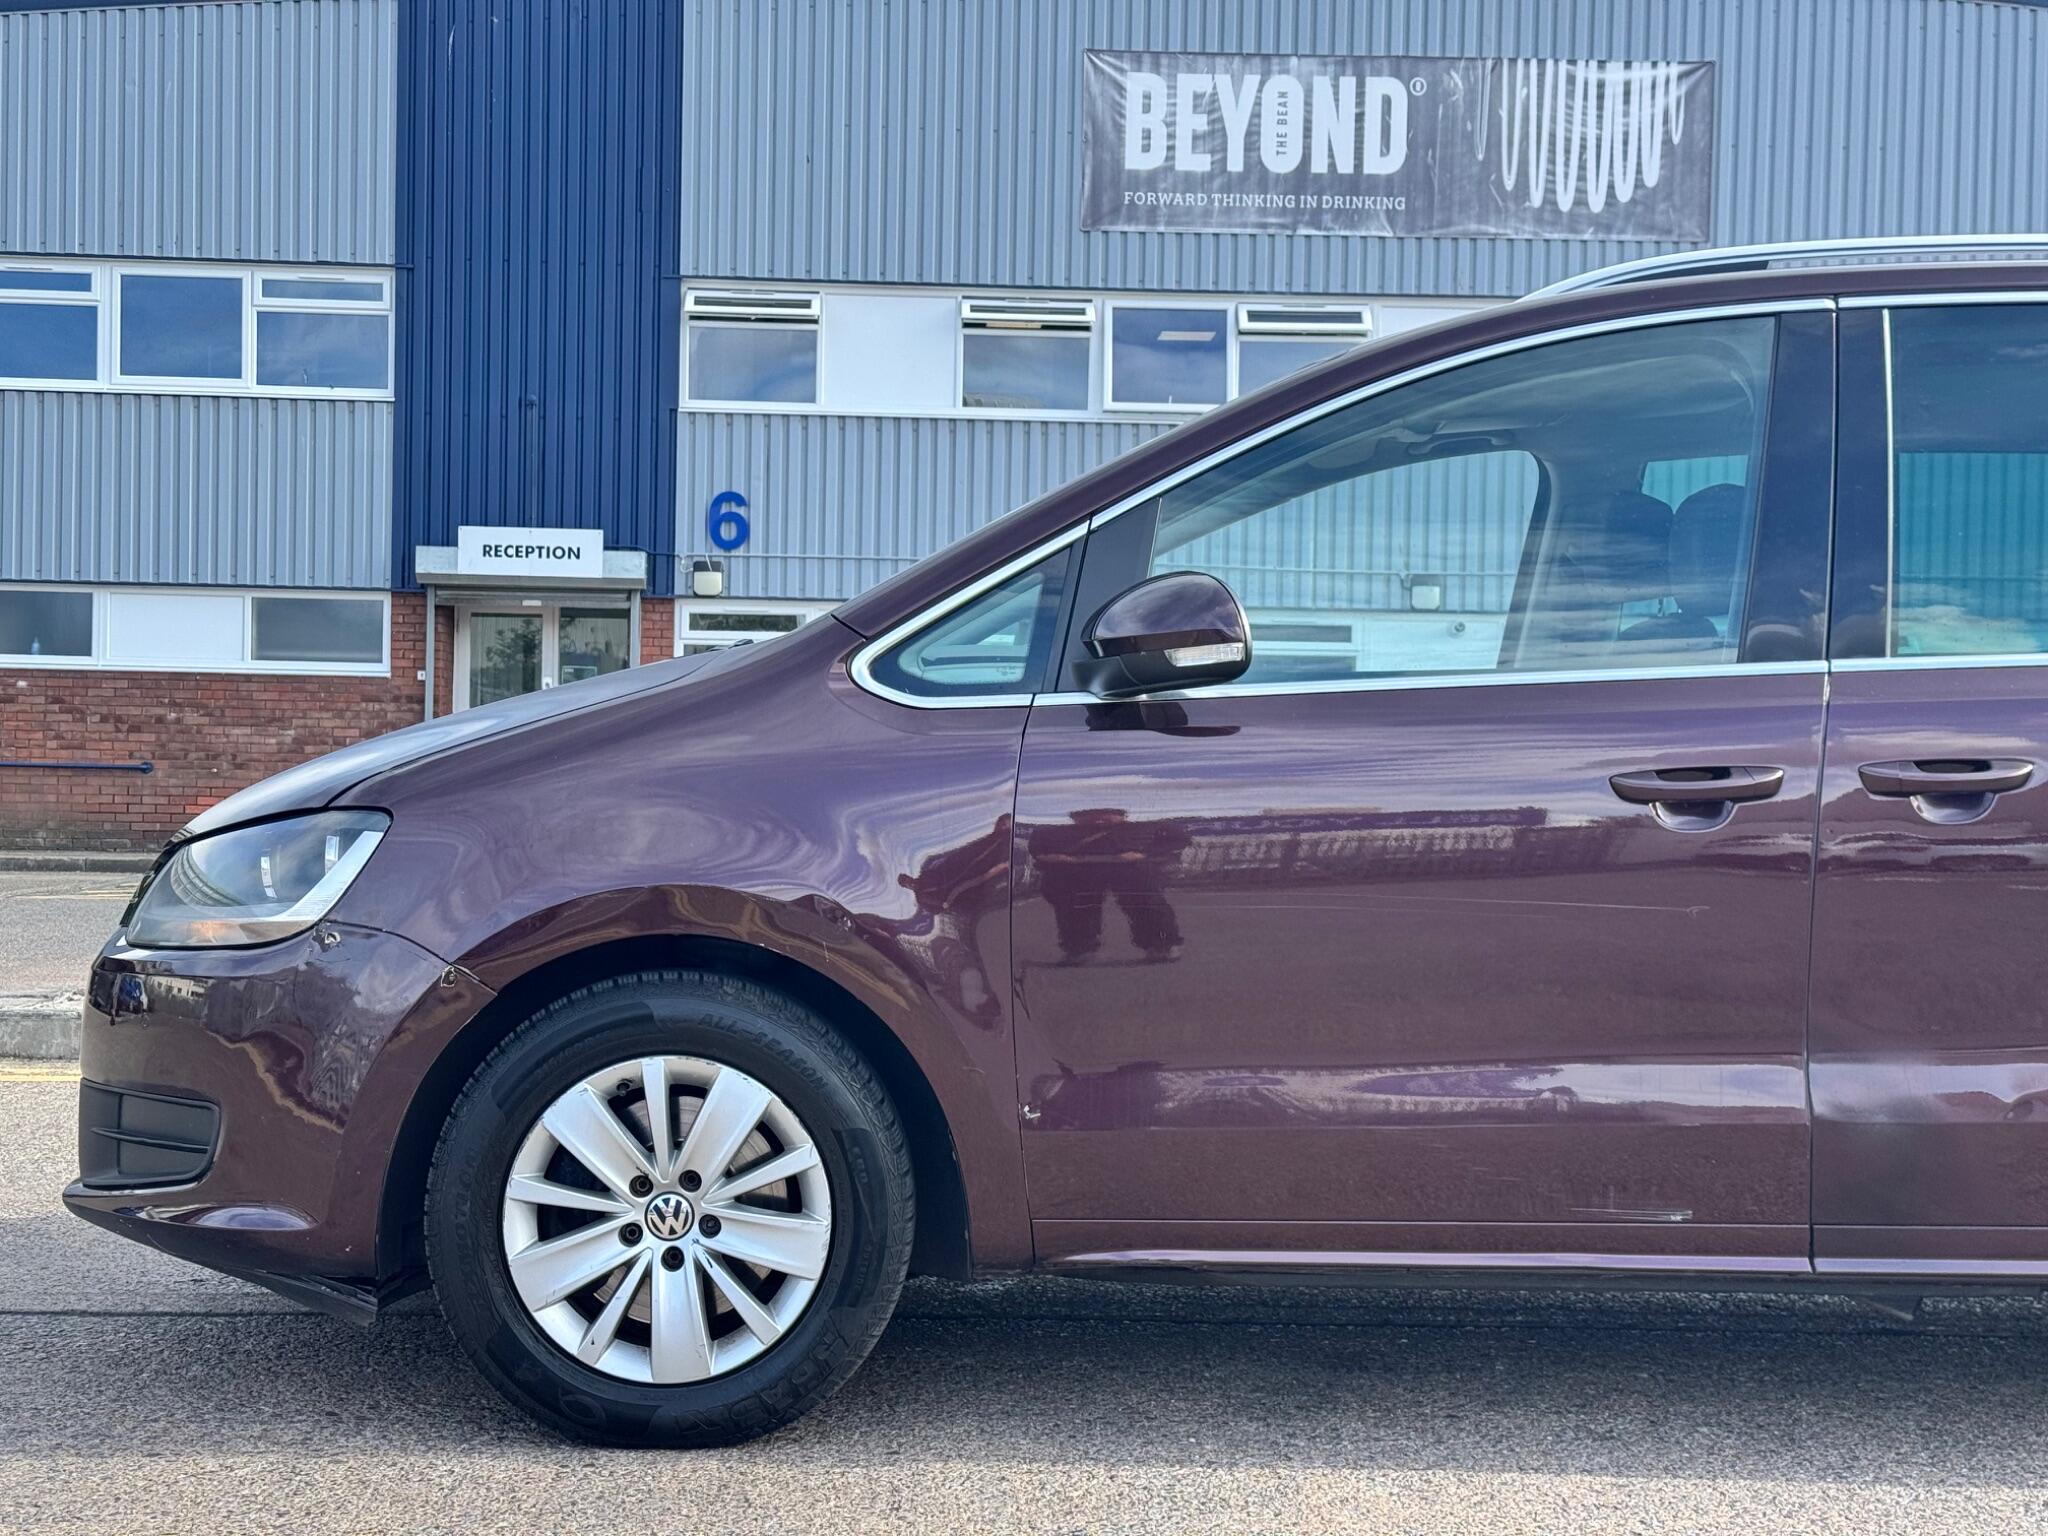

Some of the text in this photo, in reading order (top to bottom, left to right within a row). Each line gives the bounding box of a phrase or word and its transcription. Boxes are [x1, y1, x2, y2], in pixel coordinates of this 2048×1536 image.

[1124, 71, 1408, 175] BEYOND
[1276, 90, 1289, 157] THE BEAN
[1123, 190, 1406, 210] FORWARD THINKING IN DRINKING
[708, 491, 749, 551] 6
[482, 544, 581, 560] RECEPTION
